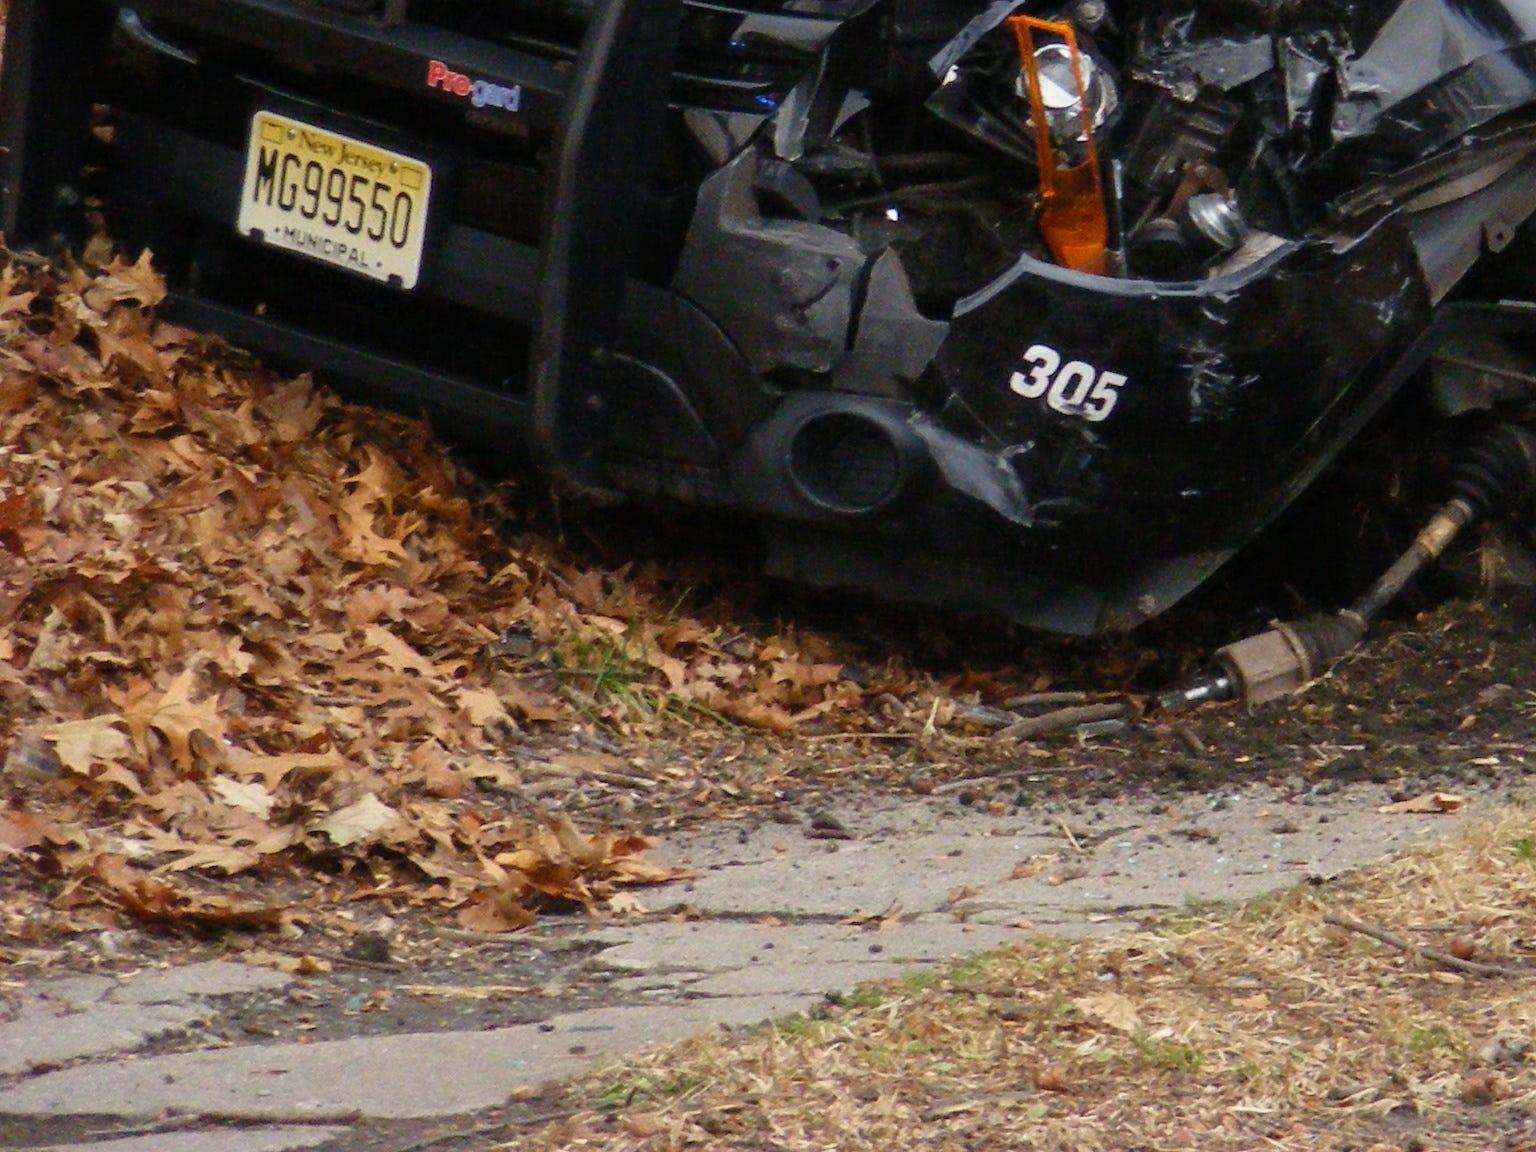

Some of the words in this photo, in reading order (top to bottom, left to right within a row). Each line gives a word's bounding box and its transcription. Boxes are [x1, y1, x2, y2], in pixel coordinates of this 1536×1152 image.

[300, 131, 336, 159] New
[336, 142, 386, 178] Jersey
[253, 145, 413, 249] MG99550
[283, 225, 370, 269] MUNICIPAL
[1009, 344, 1128, 422] 305
